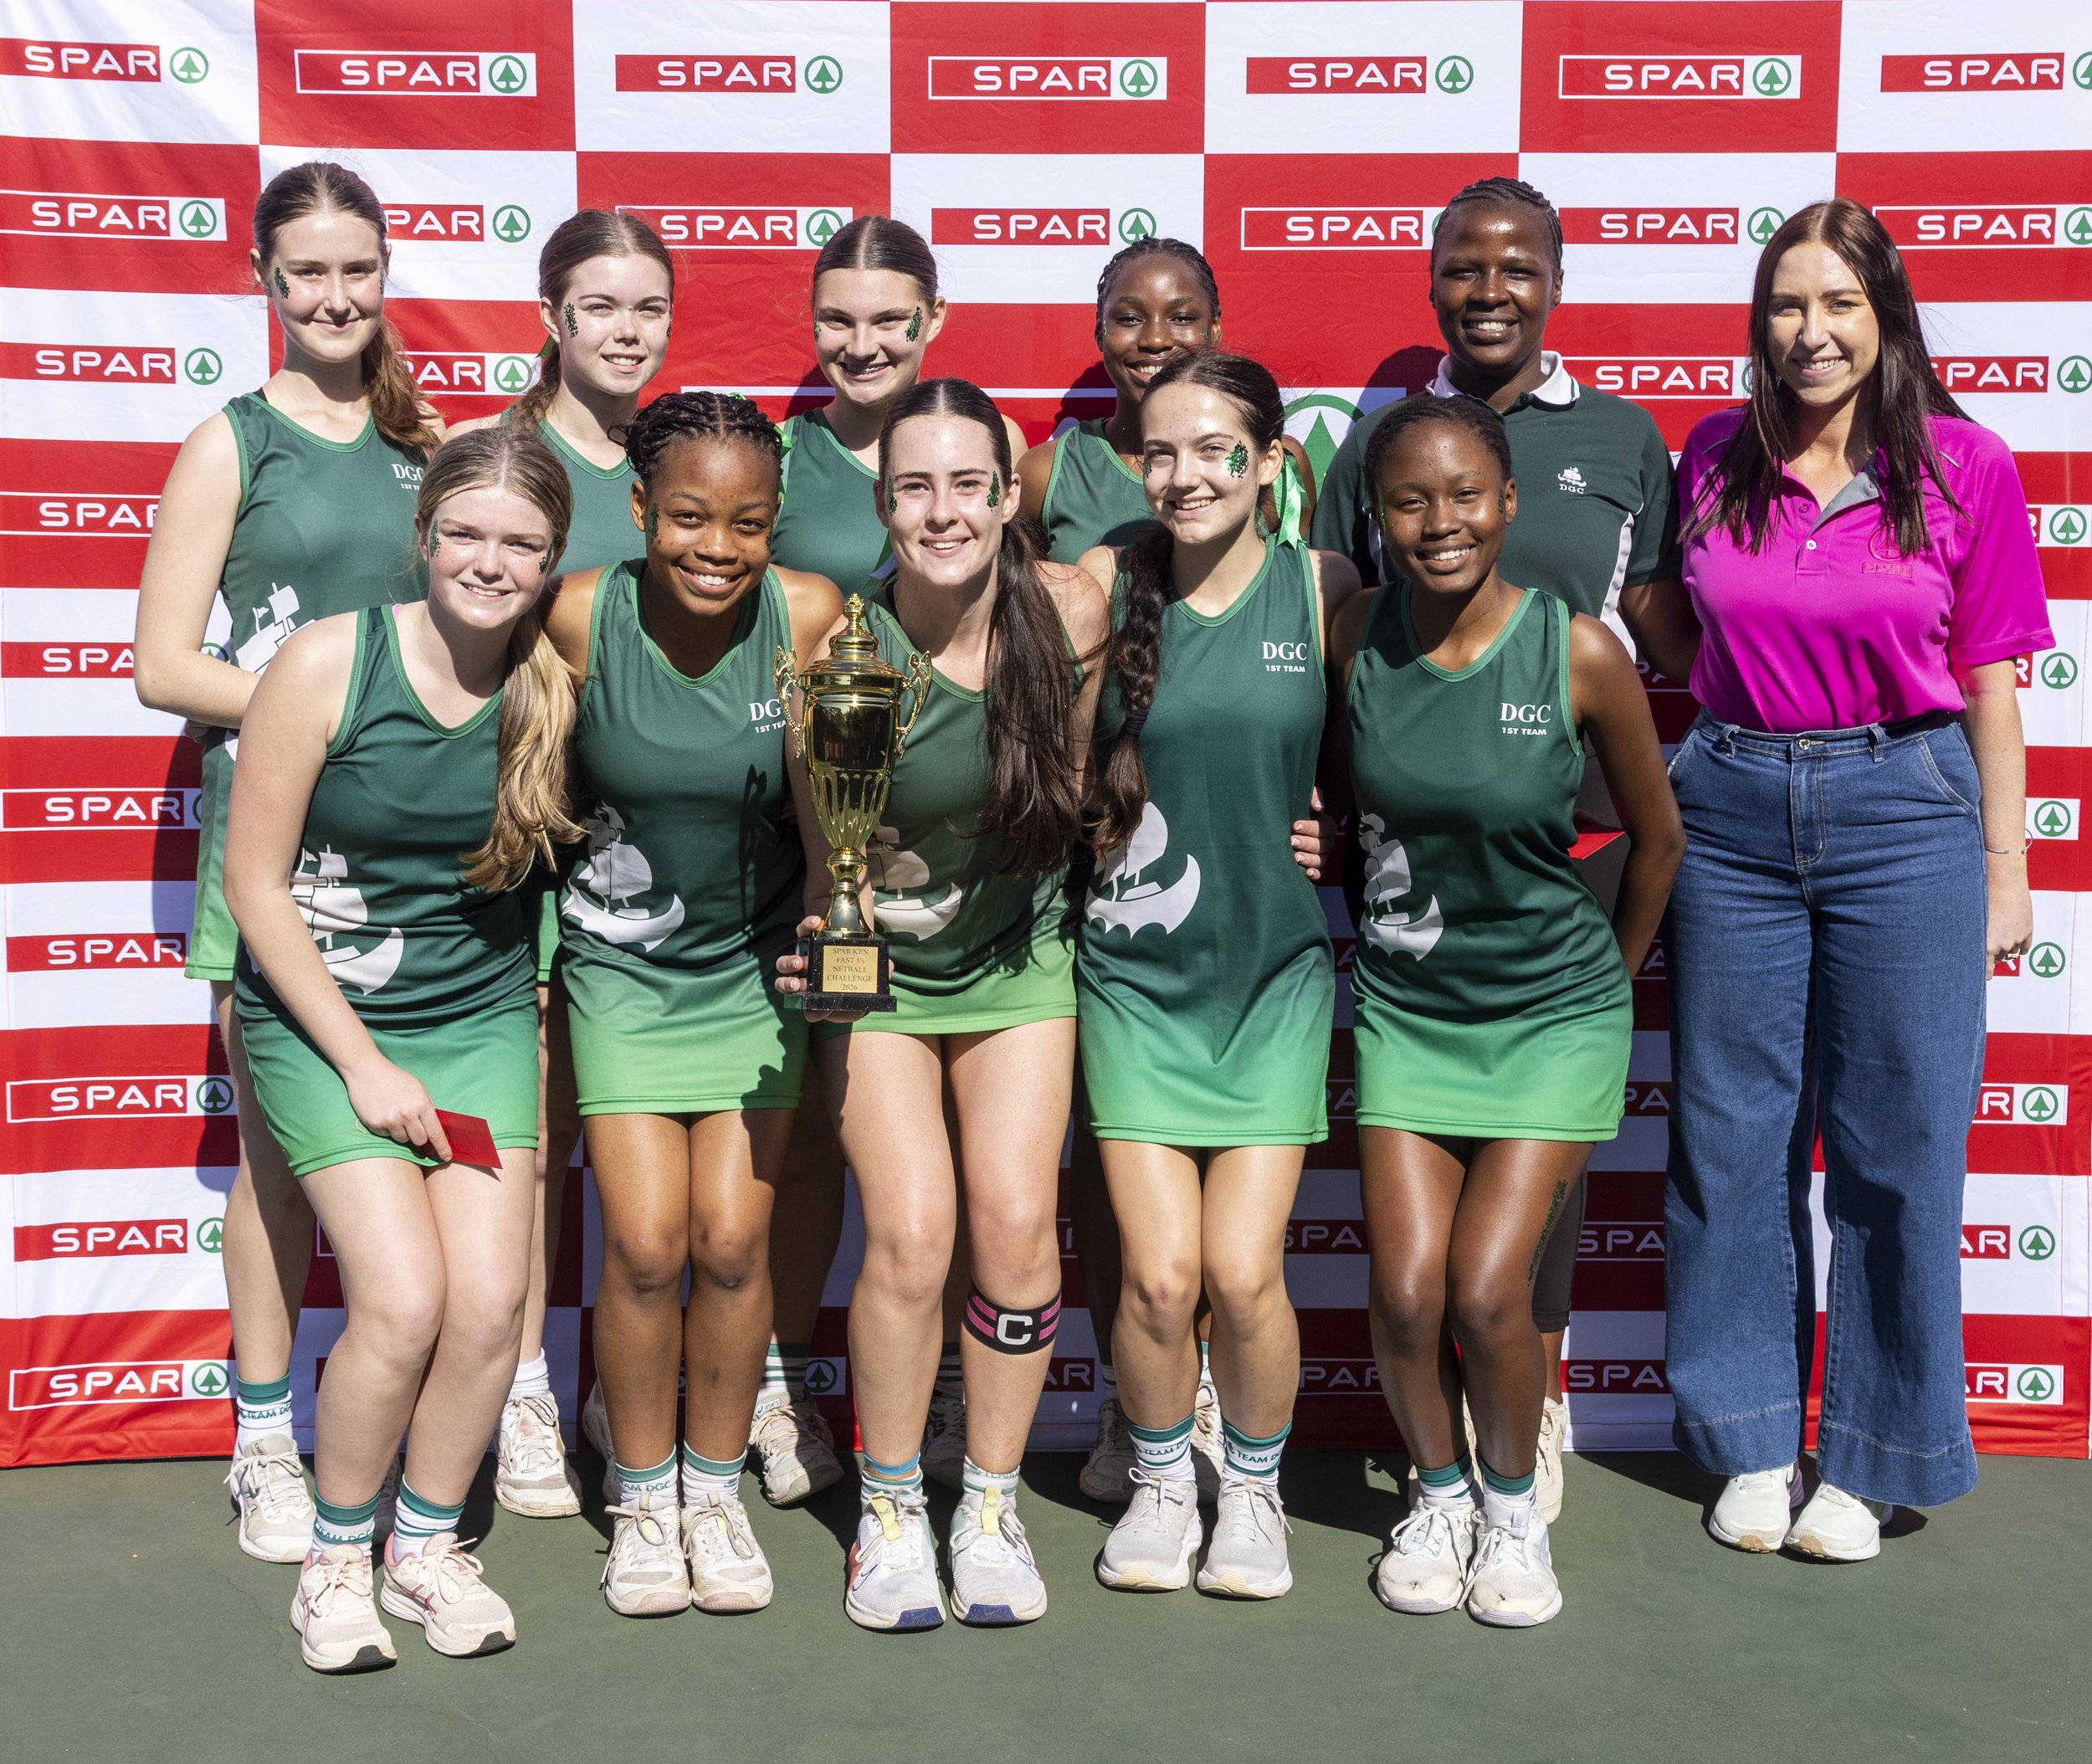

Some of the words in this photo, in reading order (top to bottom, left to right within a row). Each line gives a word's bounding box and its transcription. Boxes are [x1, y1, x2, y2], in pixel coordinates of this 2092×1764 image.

[25, 45, 158, 76] SPAR
[1924, 59, 2060, 86] SPAR
[341, 60, 477, 87] SPAR
[658, 60, 792, 87] SPAR
[974, 65, 1107, 91] SPAR
[1289, 63, 1423, 88] SPAR
[1605, 64, 1740, 90] SPAR
[31, 201, 167, 230] SPAR
[384, 209, 480, 235] PAR
[661, 214, 794, 240] SPAR
[972, 214, 1106, 239] SPAR
[1600, 213, 1735, 238] SPAR
[1916, 213, 2052, 240] SPAR
[1286, 216, 1419, 241] SPAR
[35, 349, 172, 378] SPAR
[1931, 362, 2044, 387] PAR
[1596, 365, 1731, 390] SPAR
[1559, 484, 1584, 494] DGC
[43, 648, 134, 673] SPA
[1261, 642, 1307, 661] DGC
[748, 695, 790, 721] DG
[1500, 703, 1551, 723] DGC
[755, 725, 770, 733] 1ST
[772, 720, 787, 730] TEA
[45, 797, 182, 822] SPAR
[47, 939, 182, 964] SPAR
[50, 1084, 184, 1113] SPAR
[52, 1225, 184, 1253] SPAR
[1578, 1230, 1664, 1253] SPA
[997, 1313, 1033, 1346] C
[49, 1368, 181, 1399] SPAR
[1568, 1365, 1664, 1388] SPA
[1237, 1450, 1268, 1464] TEAM
